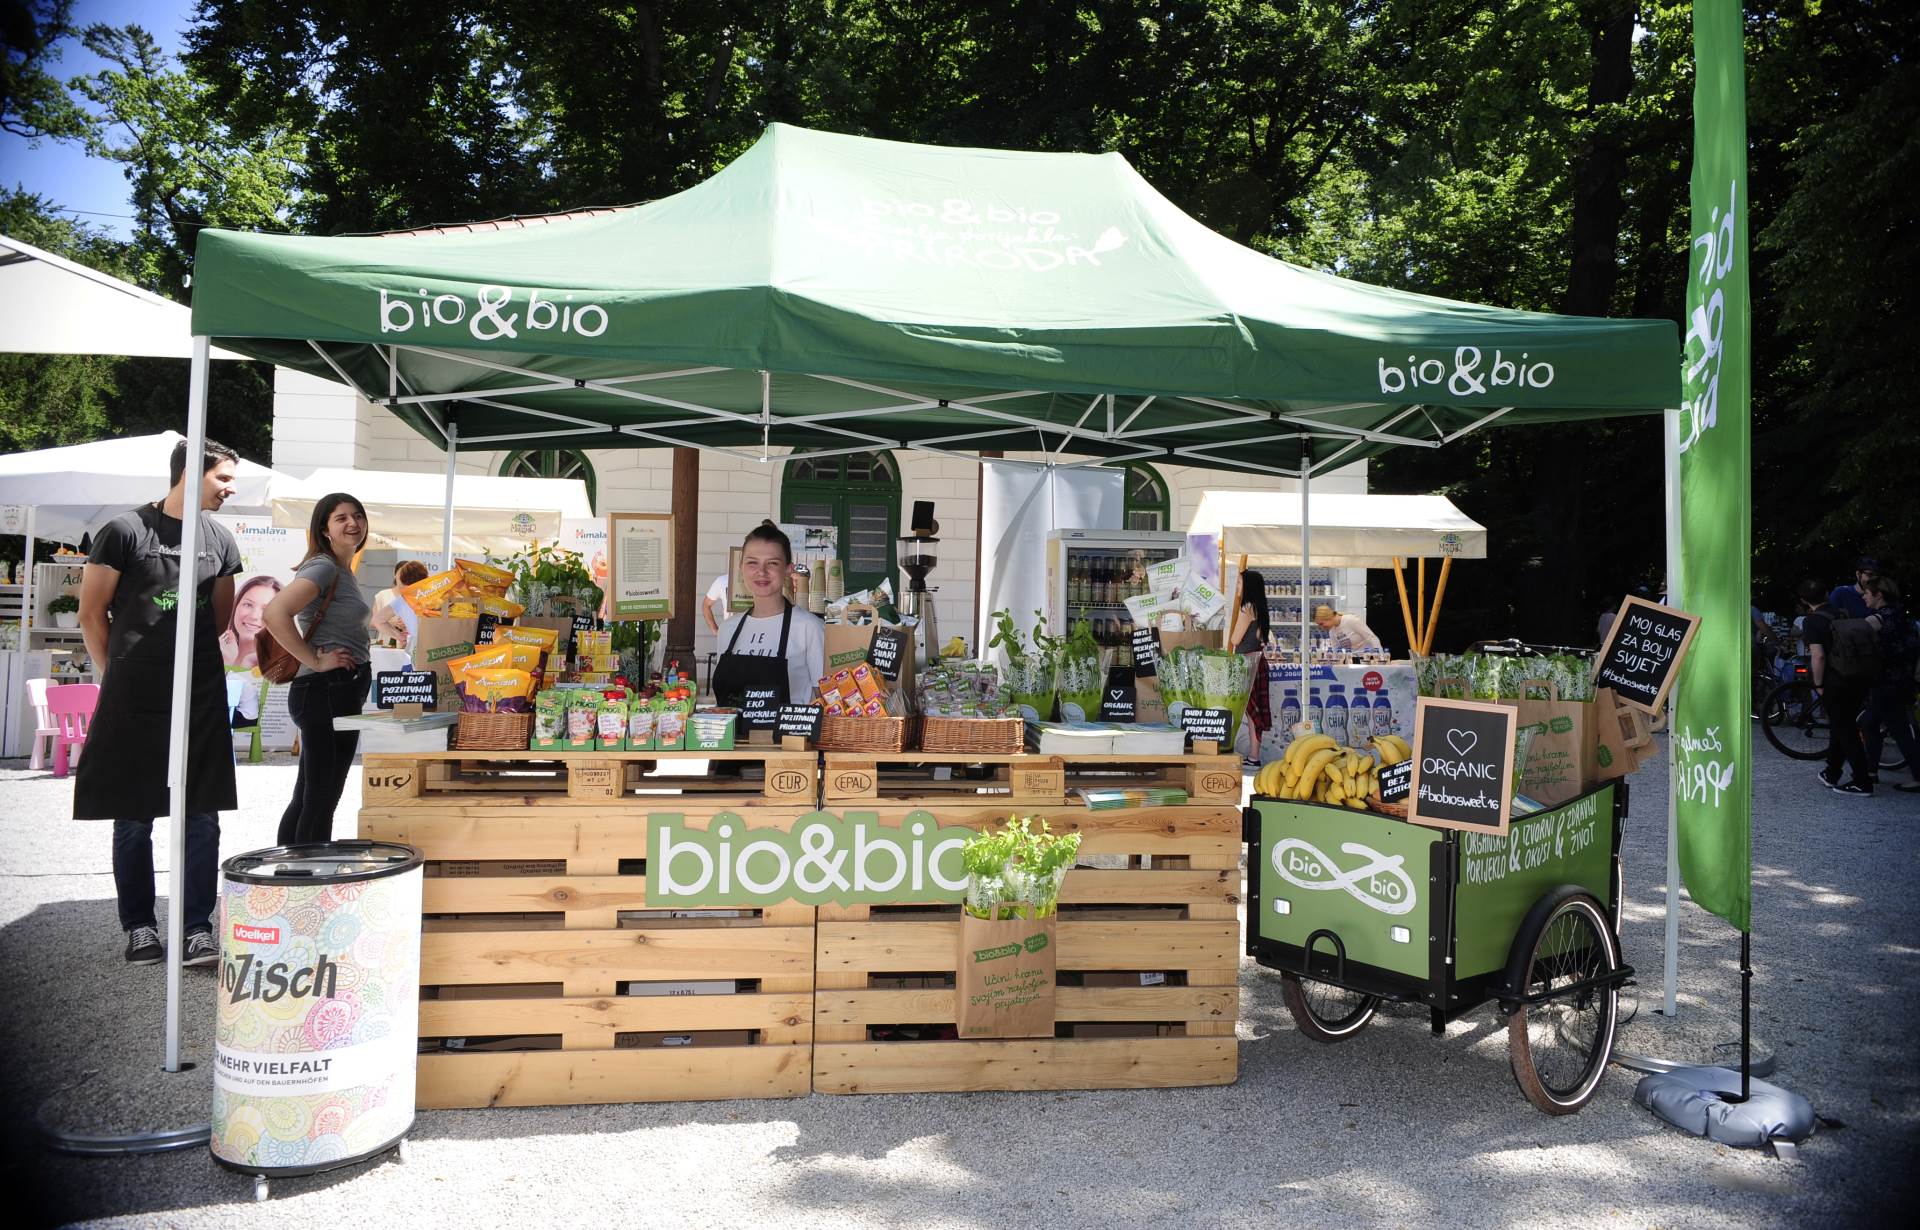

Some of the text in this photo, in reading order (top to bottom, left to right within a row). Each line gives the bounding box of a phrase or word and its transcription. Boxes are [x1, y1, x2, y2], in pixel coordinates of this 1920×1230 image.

[379, 284, 609, 341] bio&bio
[1378, 346, 1555, 396] bio&bio
[1629, 615, 1682, 641] MOJ GLAS
[1621, 633, 1672, 662] ZA BOLJI
[1614, 650, 1661, 674] SVIJET
[380, 675, 425, 684] BUDI DIO
[746, 700, 765, 708] EKO
[1328, 716, 1345, 728] CHIA
[1353, 715, 1368, 726] CHIA
[1375, 713, 1390, 724] CHIA
[1422, 757, 1497, 780] ORGANIC
[778, 775, 802, 789] EUR
[840, 777, 865, 789] EPAL
[1206, 777, 1231, 789] EPAL
[1387, 775, 1405, 787] BEZ
[1418, 783, 1499, 810] #biobiosweet16
[1508, 826, 1521, 872] &
[1522, 814, 1555, 846] IZVORNI
[1555, 811, 1565, 859] &
[658, 823, 970, 896] bio&bio
[1289, 850, 1322, 877] bio
[1466, 821, 1595, 885] PORIJEKLO OKUSI ŽIVOT
[1369, 874, 1401, 900] bio
[235, 927, 275, 942] Voelkel
[979, 946, 1017, 960] bio&bio
[219, 1053, 250, 1073] MEHR
[253, 1058, 332, 1075] VIELFALT
